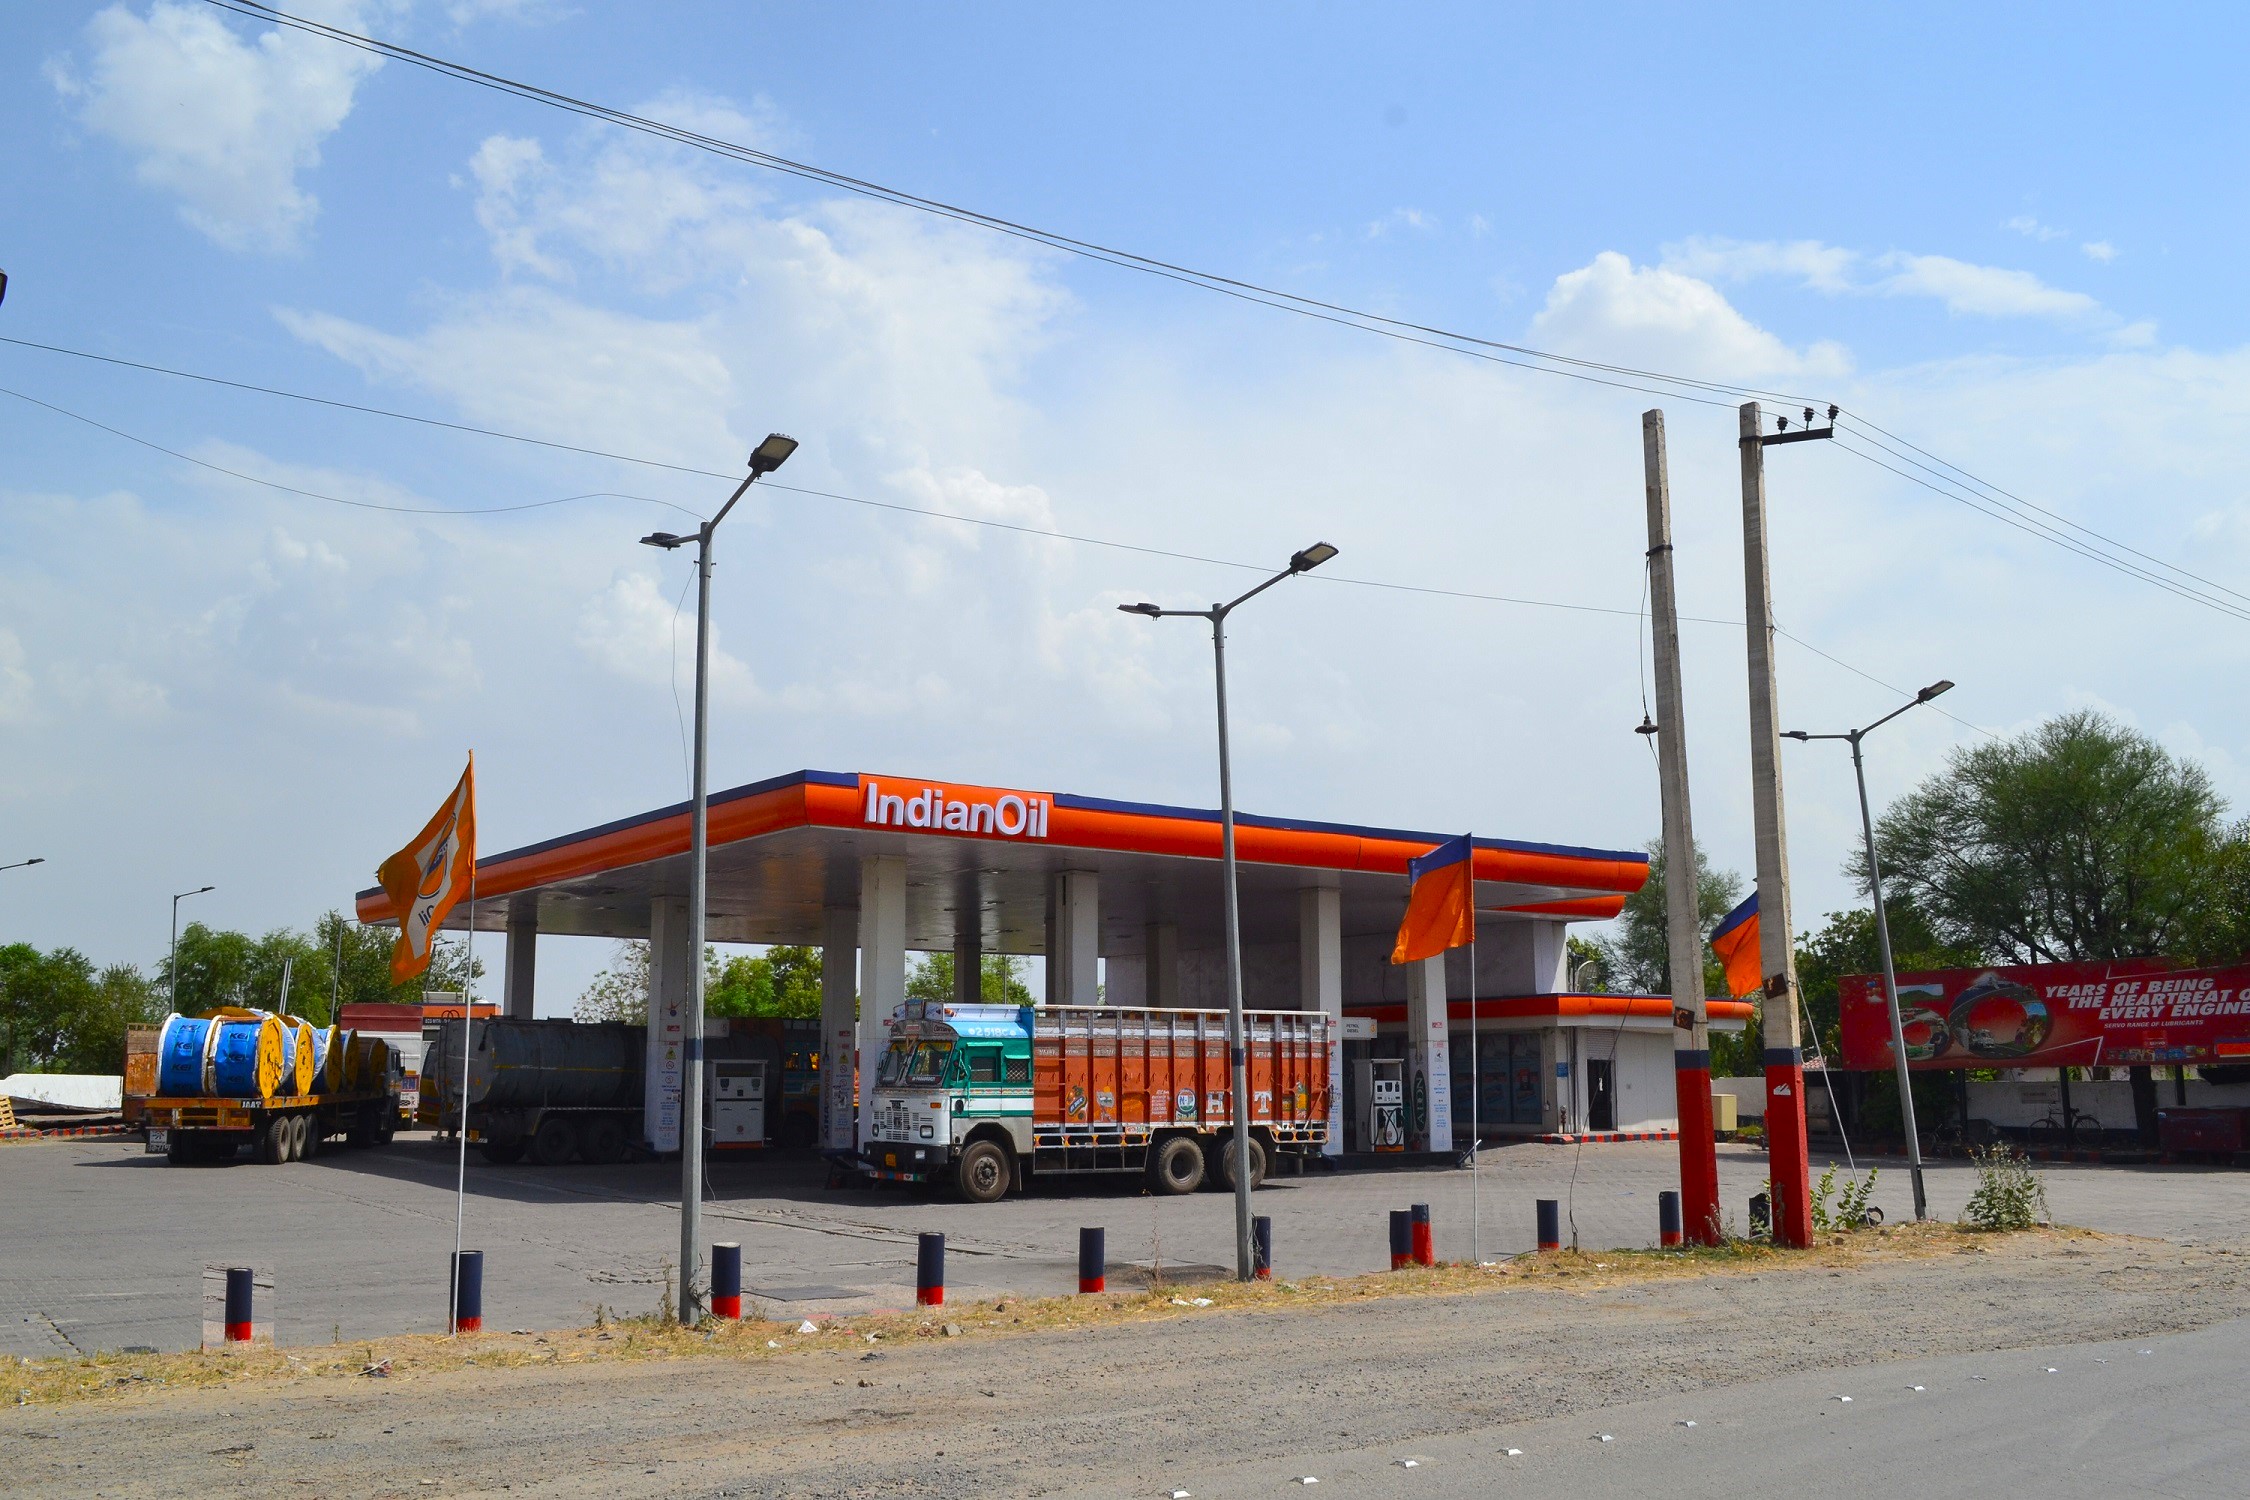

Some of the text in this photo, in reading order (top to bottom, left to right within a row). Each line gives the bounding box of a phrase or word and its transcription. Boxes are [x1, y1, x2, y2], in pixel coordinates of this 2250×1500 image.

[865, 783, 1048, 837] IndianOil
[2046, 978, 2214, 998] YEARS OF BEING
[2068, 995, 2104, 1009] THE
[2109, 989, 2232, 1007] HEARTBEAT
[2099, 1001, 2250, 1020] EVERY ENGINE
[174, 1042, 193, 1050] KEI
[171, 1064, 192, 1072] KEI
[1254, 1091, 1273, 1113] T
